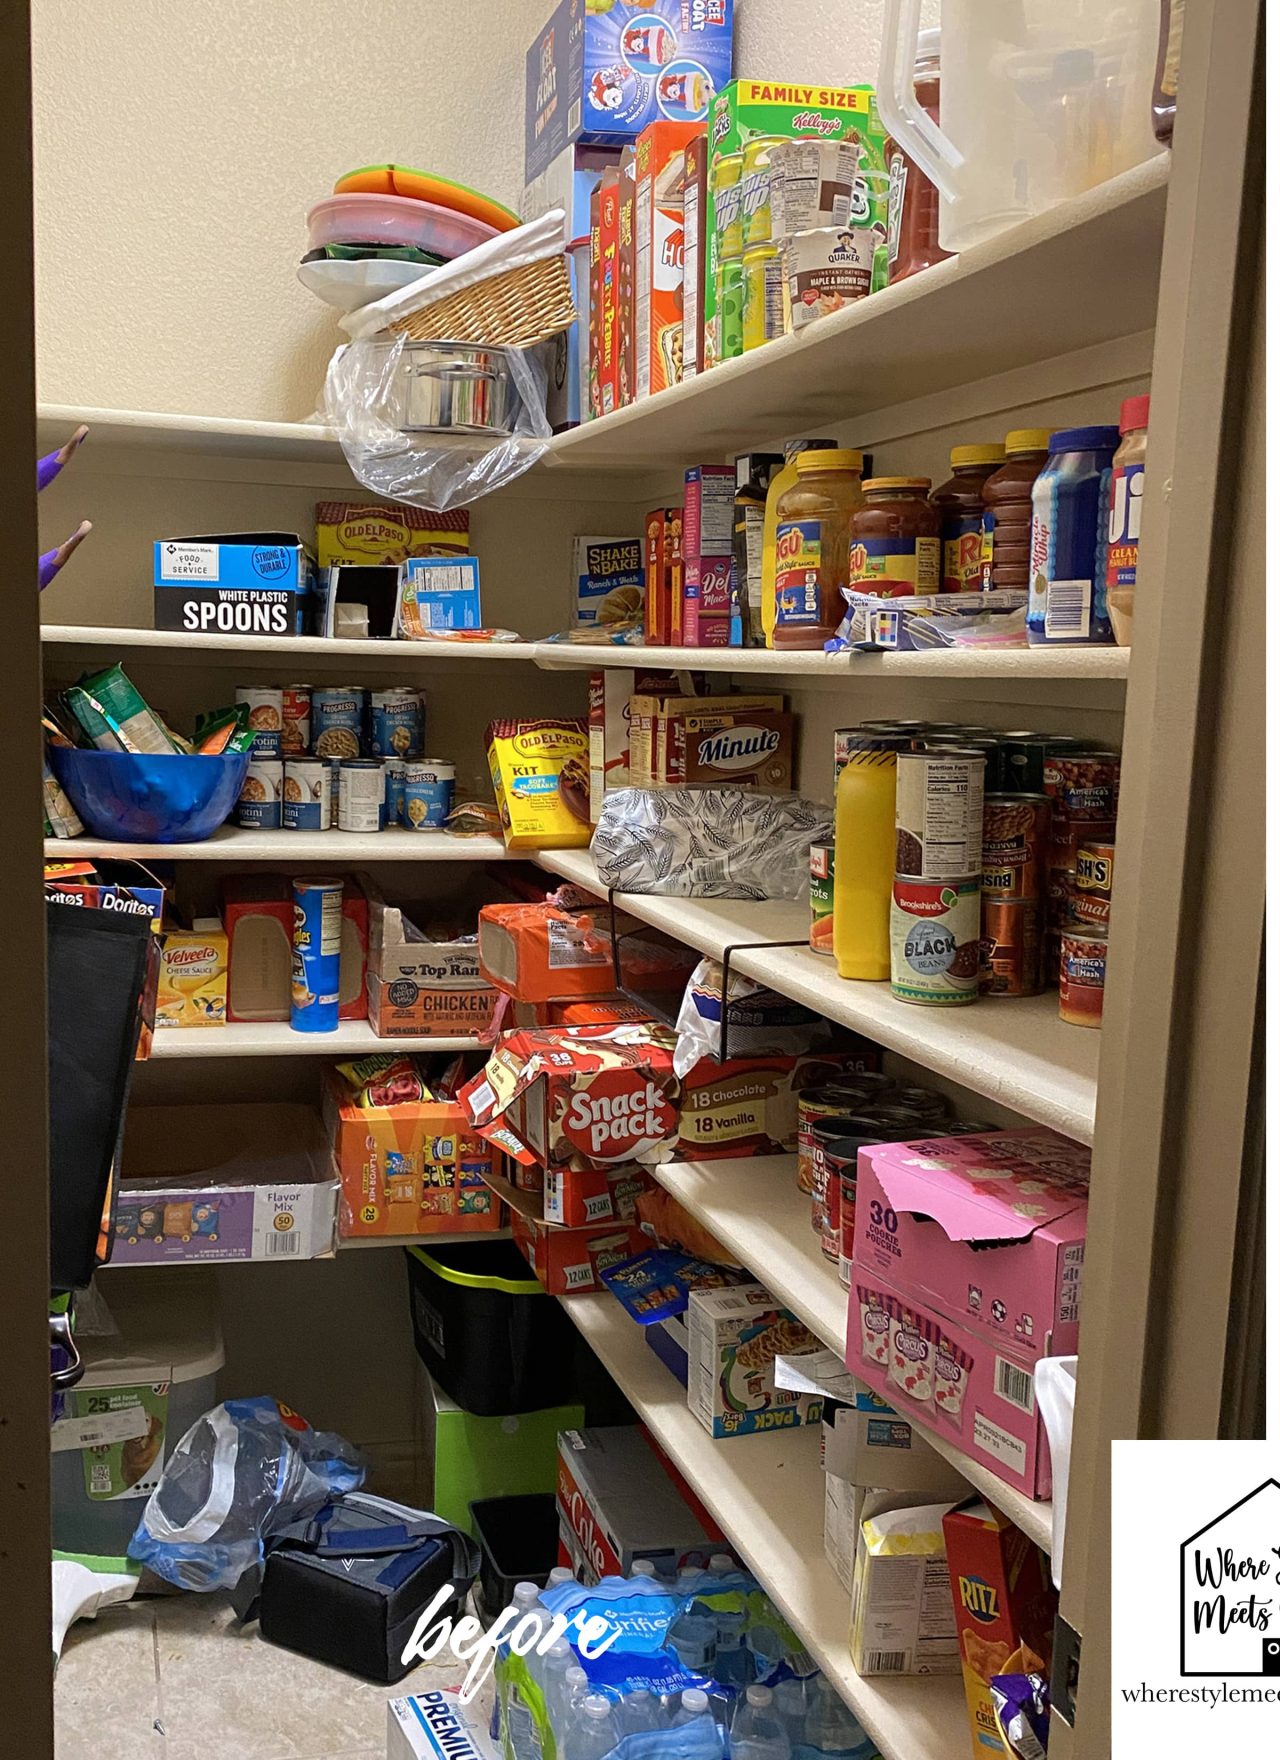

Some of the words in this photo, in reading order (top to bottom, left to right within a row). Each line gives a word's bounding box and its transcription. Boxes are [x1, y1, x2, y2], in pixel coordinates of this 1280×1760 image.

[751, 85, 813, 104] FAMILY
[819, 92, 857, 108] SIZE
[792, 112, 841, 134] Kellogg's
[828, 253, 859, 263] QUAKER
[603, 241, 615, 309] FRUITY
[810, 276, 830, 286] MAPLE
[603, 309, 615, 368] PEBBLES
[179, 554, 200, 563] FOOD
[255, 551, 277, 564] STRONG
[590, 545, 639, 563] SHAKE
[172, 566, 207, 574] SERVICE
[259, 561, 286, 573] DURABLE
[601, 559, 638, 575] BAKE
[586, 579, 610, 590] Ranch
[619, 576, 639, 585] Herb
[219, 590, 247, 602] WHITE
[250, 591, 288, 603] PLASTIC
[183, 602, 288, 632] SPOONS
[321, 702, 357, 713] PROGRESSO
[384, 702, 417, 713] PROGRESSO
[698, 731, 778, 765] Minute
[512, 766, 538, 777] KIT
[102, 893, 155, 916] Doritos
[900, 899, 942, 911] Brookshire's
[904, 936, 956, 958] BLACK
[164, 947, 215, 964] Velveeta
[917, 958, 946, 968] BEANS
[166, 967, 190, 975] CHEESE
[192, 966, 212, 974] SAUCE
[419, 964, 446, 978] Top
[424, 996, 488, 1010] CHICKEN
[691, 1093, 710, 1108] 18
[712, 1084, 766, 1103] Chocolate
[569, 1082, 666, 1129] Snack
[695, 1116, 713, 1132] 18
[715, 1113, 755, 1129] Vanilla
[591, 1110, 665, 1152] pack
[267, 1192, 301, 1203] Flavor
[274, 1202, 293, 1212] Mix
[588, 1201, 599, 1214] 12
[869, 1200, 898, 1234] 30
[869, 1223, 899, 1246] COOKIE
[864, 1230, 902, 1258] POUCHES
[895, 1333, 928, 1359] CIRCUS
[88, 1397, 109, 1413] 25
[754, 1410, 795, 1430] PACK
[569, 1491, 605, 1572] Coke
[959, 1576, 1000, 1618] RITZ
